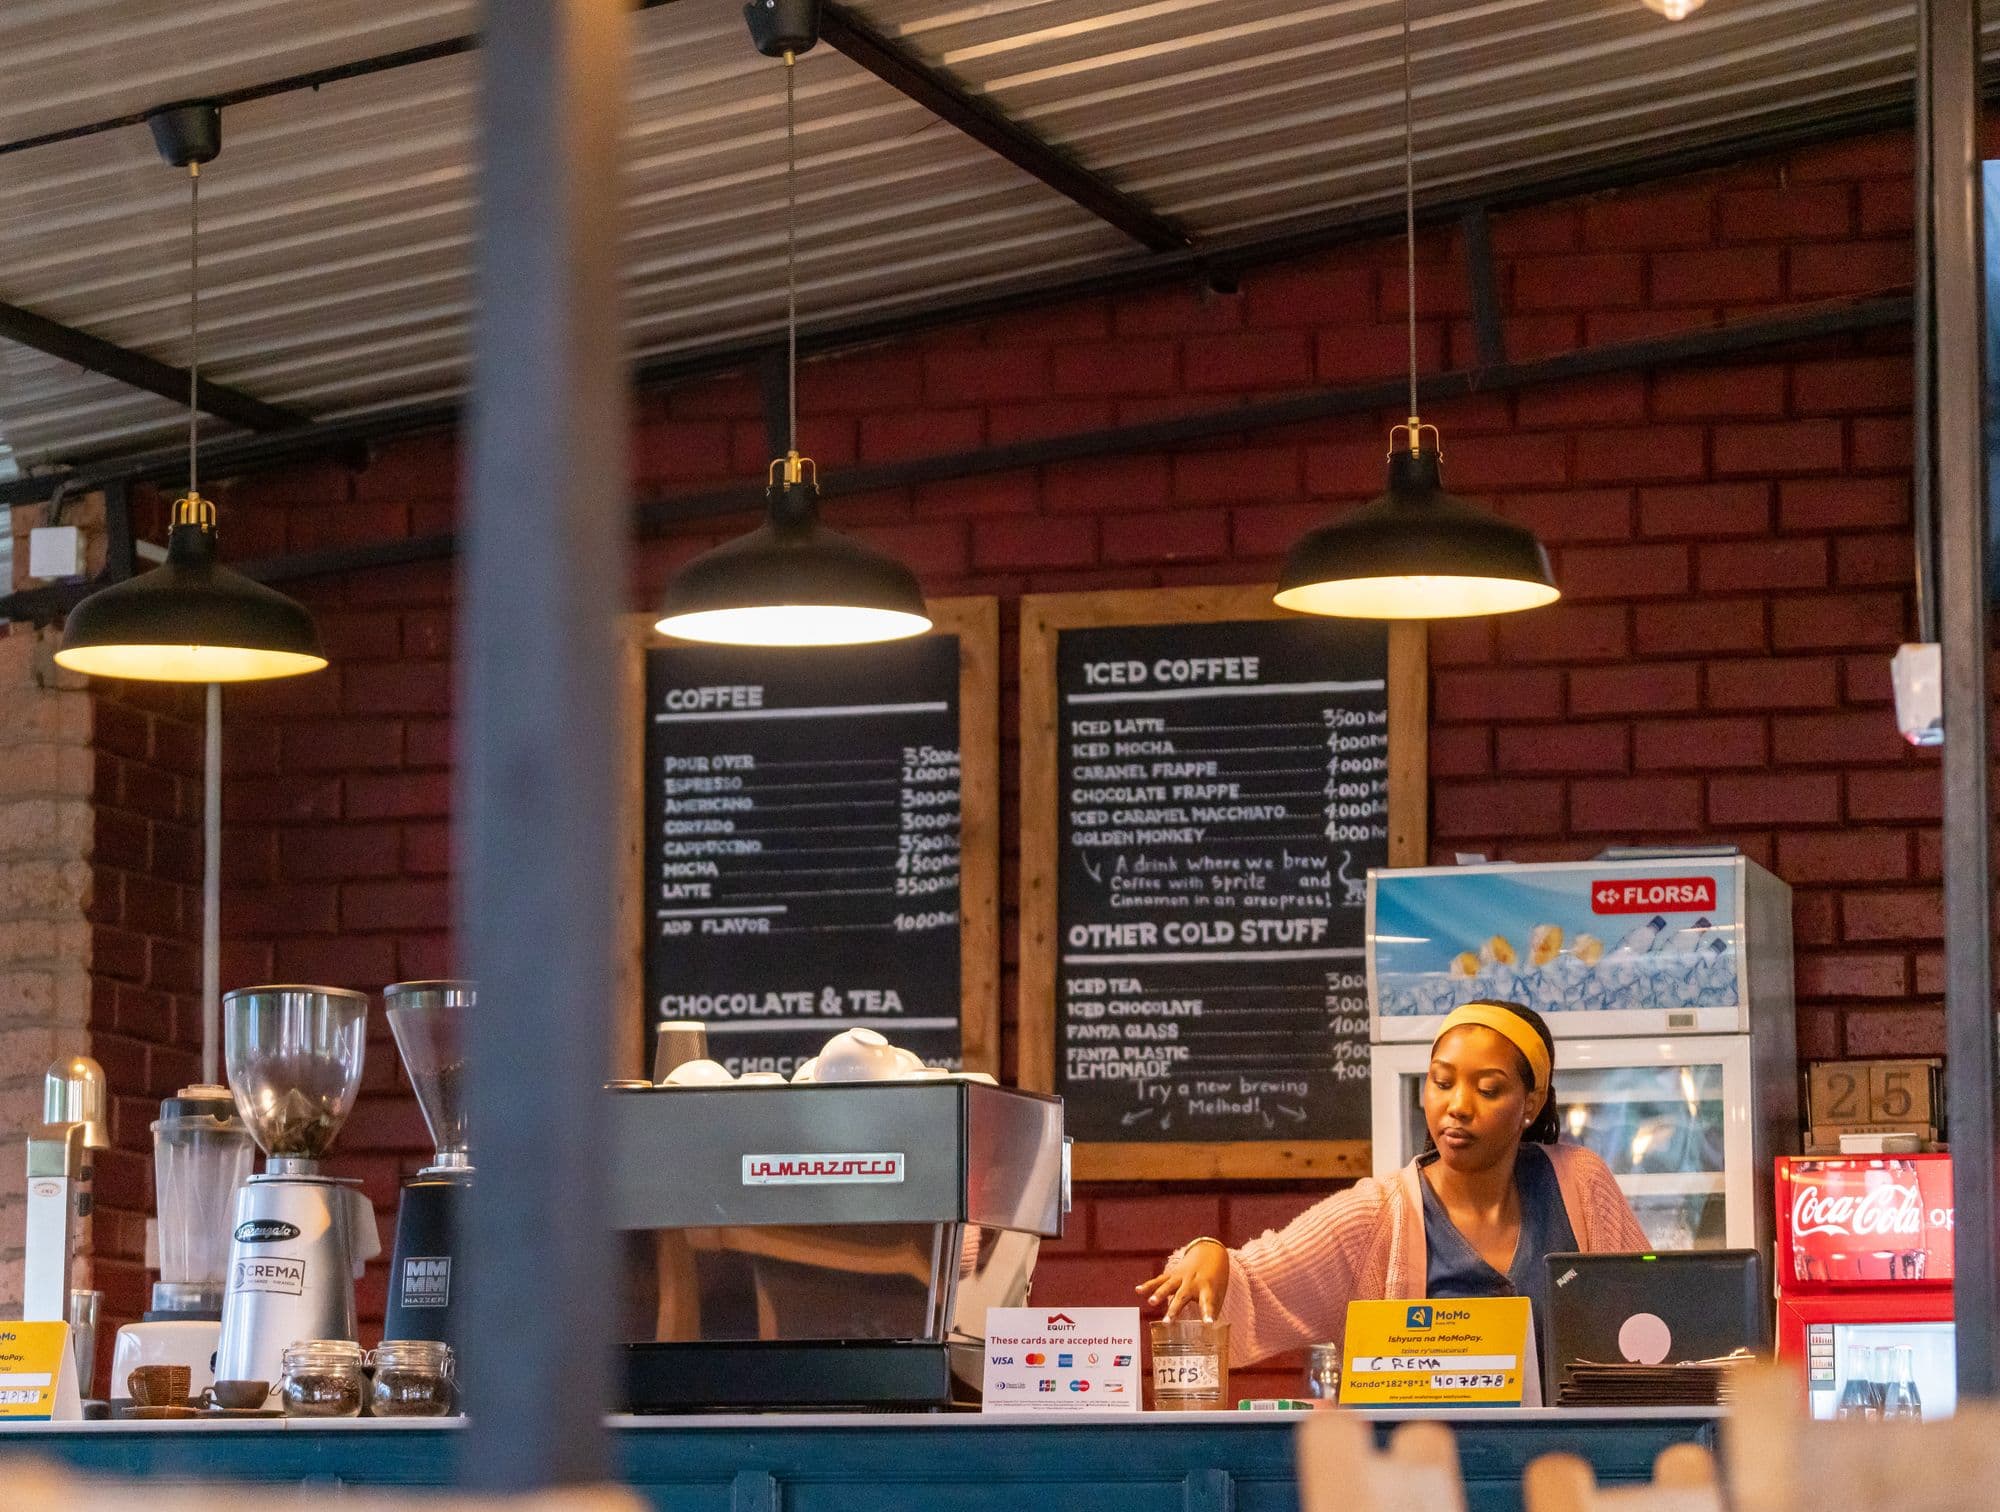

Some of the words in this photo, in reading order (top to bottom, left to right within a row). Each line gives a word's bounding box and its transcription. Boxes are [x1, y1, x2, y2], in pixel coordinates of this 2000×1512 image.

[1084, 661, 1147, 685] ICED
[1154, 657, 1260, 682] COFFEE
[666, 686, 764, 710] COFFEE
[1072, 720, 1111, 736] ICED
[1114, 718, 1165, 735] LATTE
[1072, 742, 1112, 758] ICED
[1115, 740, 1175, 756] MOCHA
[664, 756, 710, 773] POUR
[712, 754, 754, 769] OVER
[1072, 764, 1148, 781] CARAMEL
[1152, 761, 1217, 778] FRAPPE
[664, 776, 743, 795] ESPRESSO
[1072, 785, 1166, 803] CHOCOLATE
[1173, 783, 1240, 799] FRAPPE
[664, 797, 754, 815] AMERICANO
[1071, 809, 1110, 826] ICED
[1113, 807, 1189, 823] CARAMEL
[1192, 805, 1286, 821] MACCHIATO
[1072, 829, 1134, 846] GOLDEN
[1137, 827, 1205, 844] MONKEY
[663, 861, 719, 878] MOCHA
[1116, 854, 1129, 873] A
[1134, 853, 1178, 873] drink
[1246, 858, 1273, 870] we
[1284, 848, 1328, 870] brew
[1299, 870, 1331, 888] and
[663, 883, 711, 898] LATTE
[1623, 885, 1710, 905] FLORSA
[1111, 893, 1189, 908] Cinnamon
[1194, 894, 1210, 906] in
[1214, 895, 1235, 907] an
[702, 918, 770, 935] FLAVOR
[1069, 922, 1157, 948] OTHER
[1163, 920, 1235, 945] COLD
[1241, 918, 1328, 943] STUFF
[1067, 978, 1106, 995] ICED
[1109, 978, 1142, 995] TEA
[1325, 972, 1367, 991] 300
[660, 991, 814, 1018] CHOCOLATE
[820, 986, 842, 1016] &
[846, 990, 903, 1014] TEA
[1067, 1001, 1105, 1018] ICED
[1108, 999, 1203, 1017] CHOCOLATE
[1066, 1023, 1121, 1041] FANTA
[1125, 1022, 1179, 1040] GLASS
[1066, 1047, 1121, 1062] FANTA
[1124, 1045, 1190, 1062] PLASTIC
[724, 1055, 800, 1075] CHOC
[1066, 1060, 1171, 1081] LEMONADE
[1131, 1078, 1172, 1104] Try
[1178, 1084, 1190, 1096] a
[1197, 1080, 1232, 1094] new
[1240, 1075, 1308, 1097] brewing
[1826, 1071, 1912, 1118] 25
[1792, 1183, 1921, 1237] Coca-Cola
[246, 1265, 300, 1280] CREMA
[1436, 1310, 1471, 1320] MoMo
[990, 1336, 1018, 1345] These
[1021, 1336, 1047, 1345] cards
[1067, 1336, 1109, 1346] accepted
[1111, 1336, 1134, 1345] here
[1438, 1334, 1483, 1344] MoMoPay.
[991, 1356, 1014, 1365] VISA
[1159, 1367, 1199, 1384] TIPS
[1434, 1375, 1504, 1387] 407878
